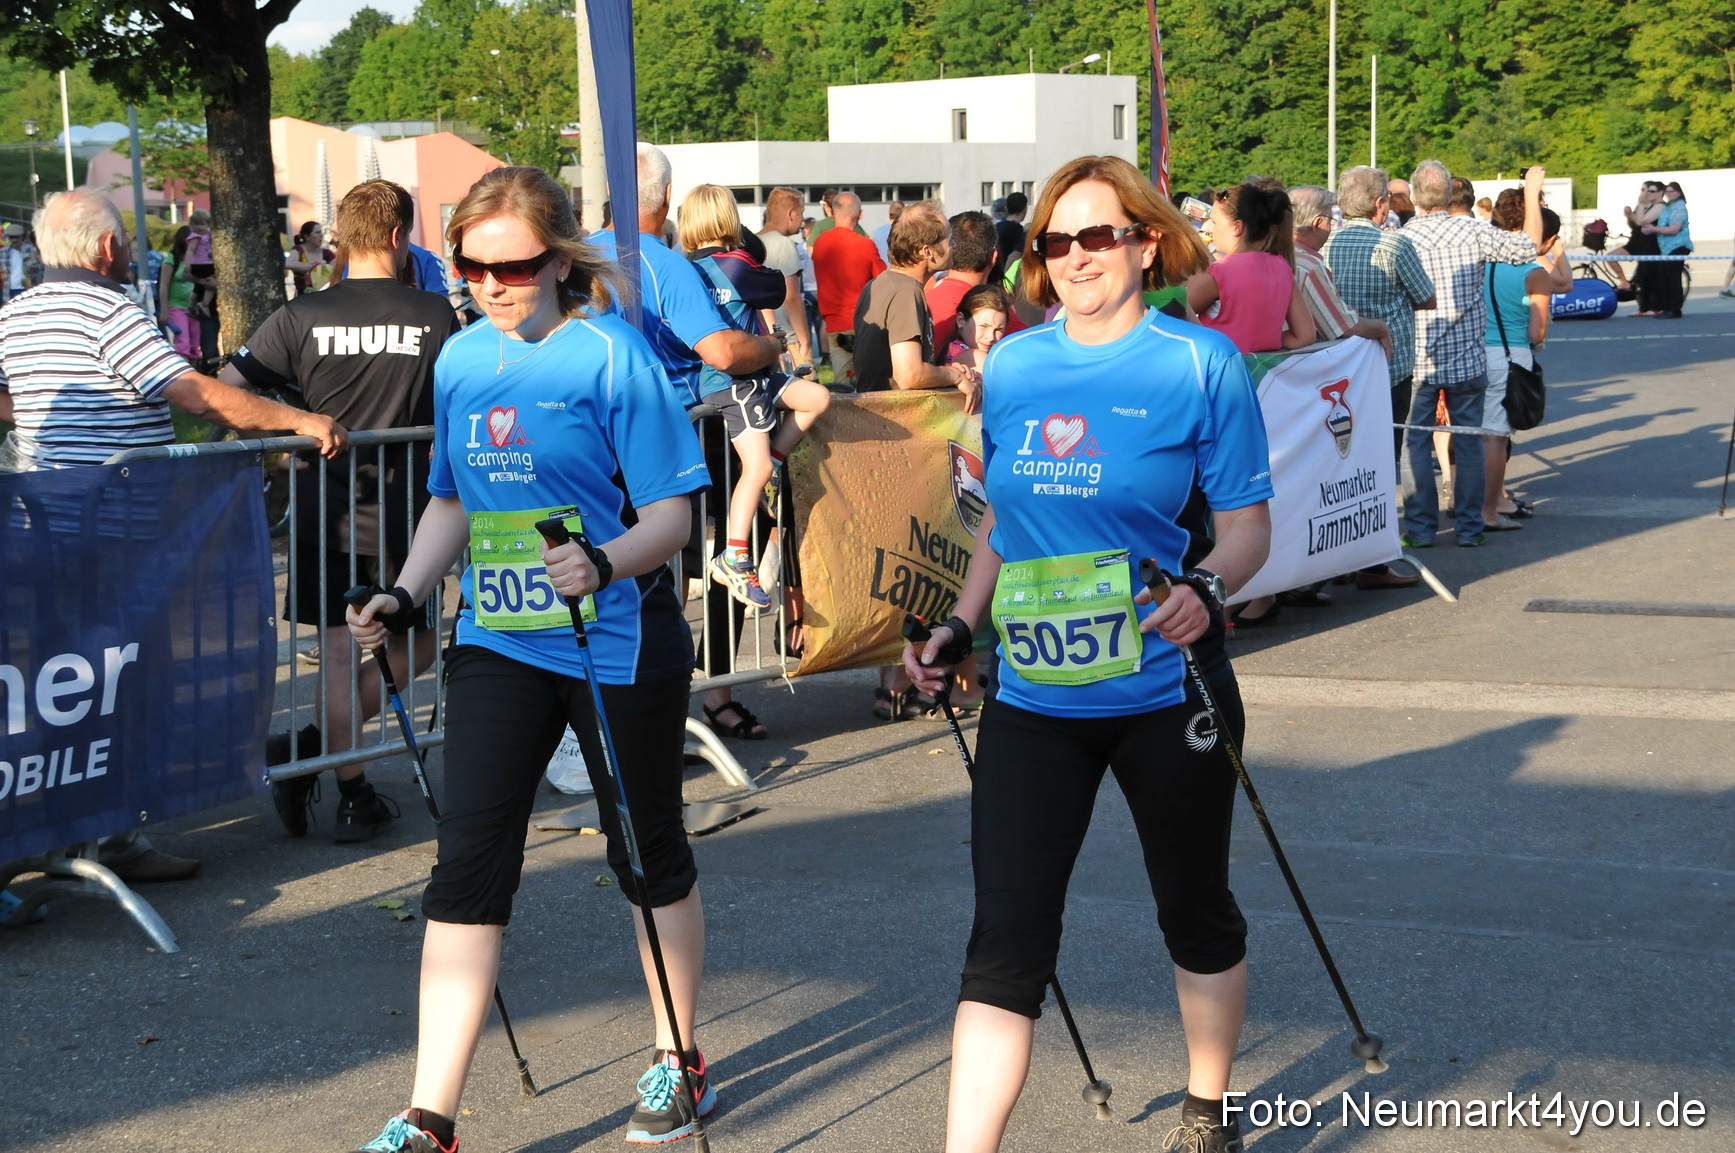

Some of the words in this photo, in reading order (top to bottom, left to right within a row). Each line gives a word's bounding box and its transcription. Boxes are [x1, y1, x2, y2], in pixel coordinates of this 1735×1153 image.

[312, 324, 423, 356] THULE
[1111, 406, 1139, 415] Regatta
[466, 414, 482, 448] I
[1016, 419, 1040, 456] I
[467, 447, 534, 471] camping
[1012, 457, 1102, 484] camping
[1065, 484, 1099, 498] Berger
[1319, 468, 1376, 509] Neumarkter
[472, 517, 495, 529] 2014
[1307, 498, 1387, 557] Lammsbräu
[479, 566, 585, 613] 505
[1004, 567, 1034, 581] 2014
[1006, 611, 1128, 667] 5057
[1188, 664, 1216, 715] HUDORA
